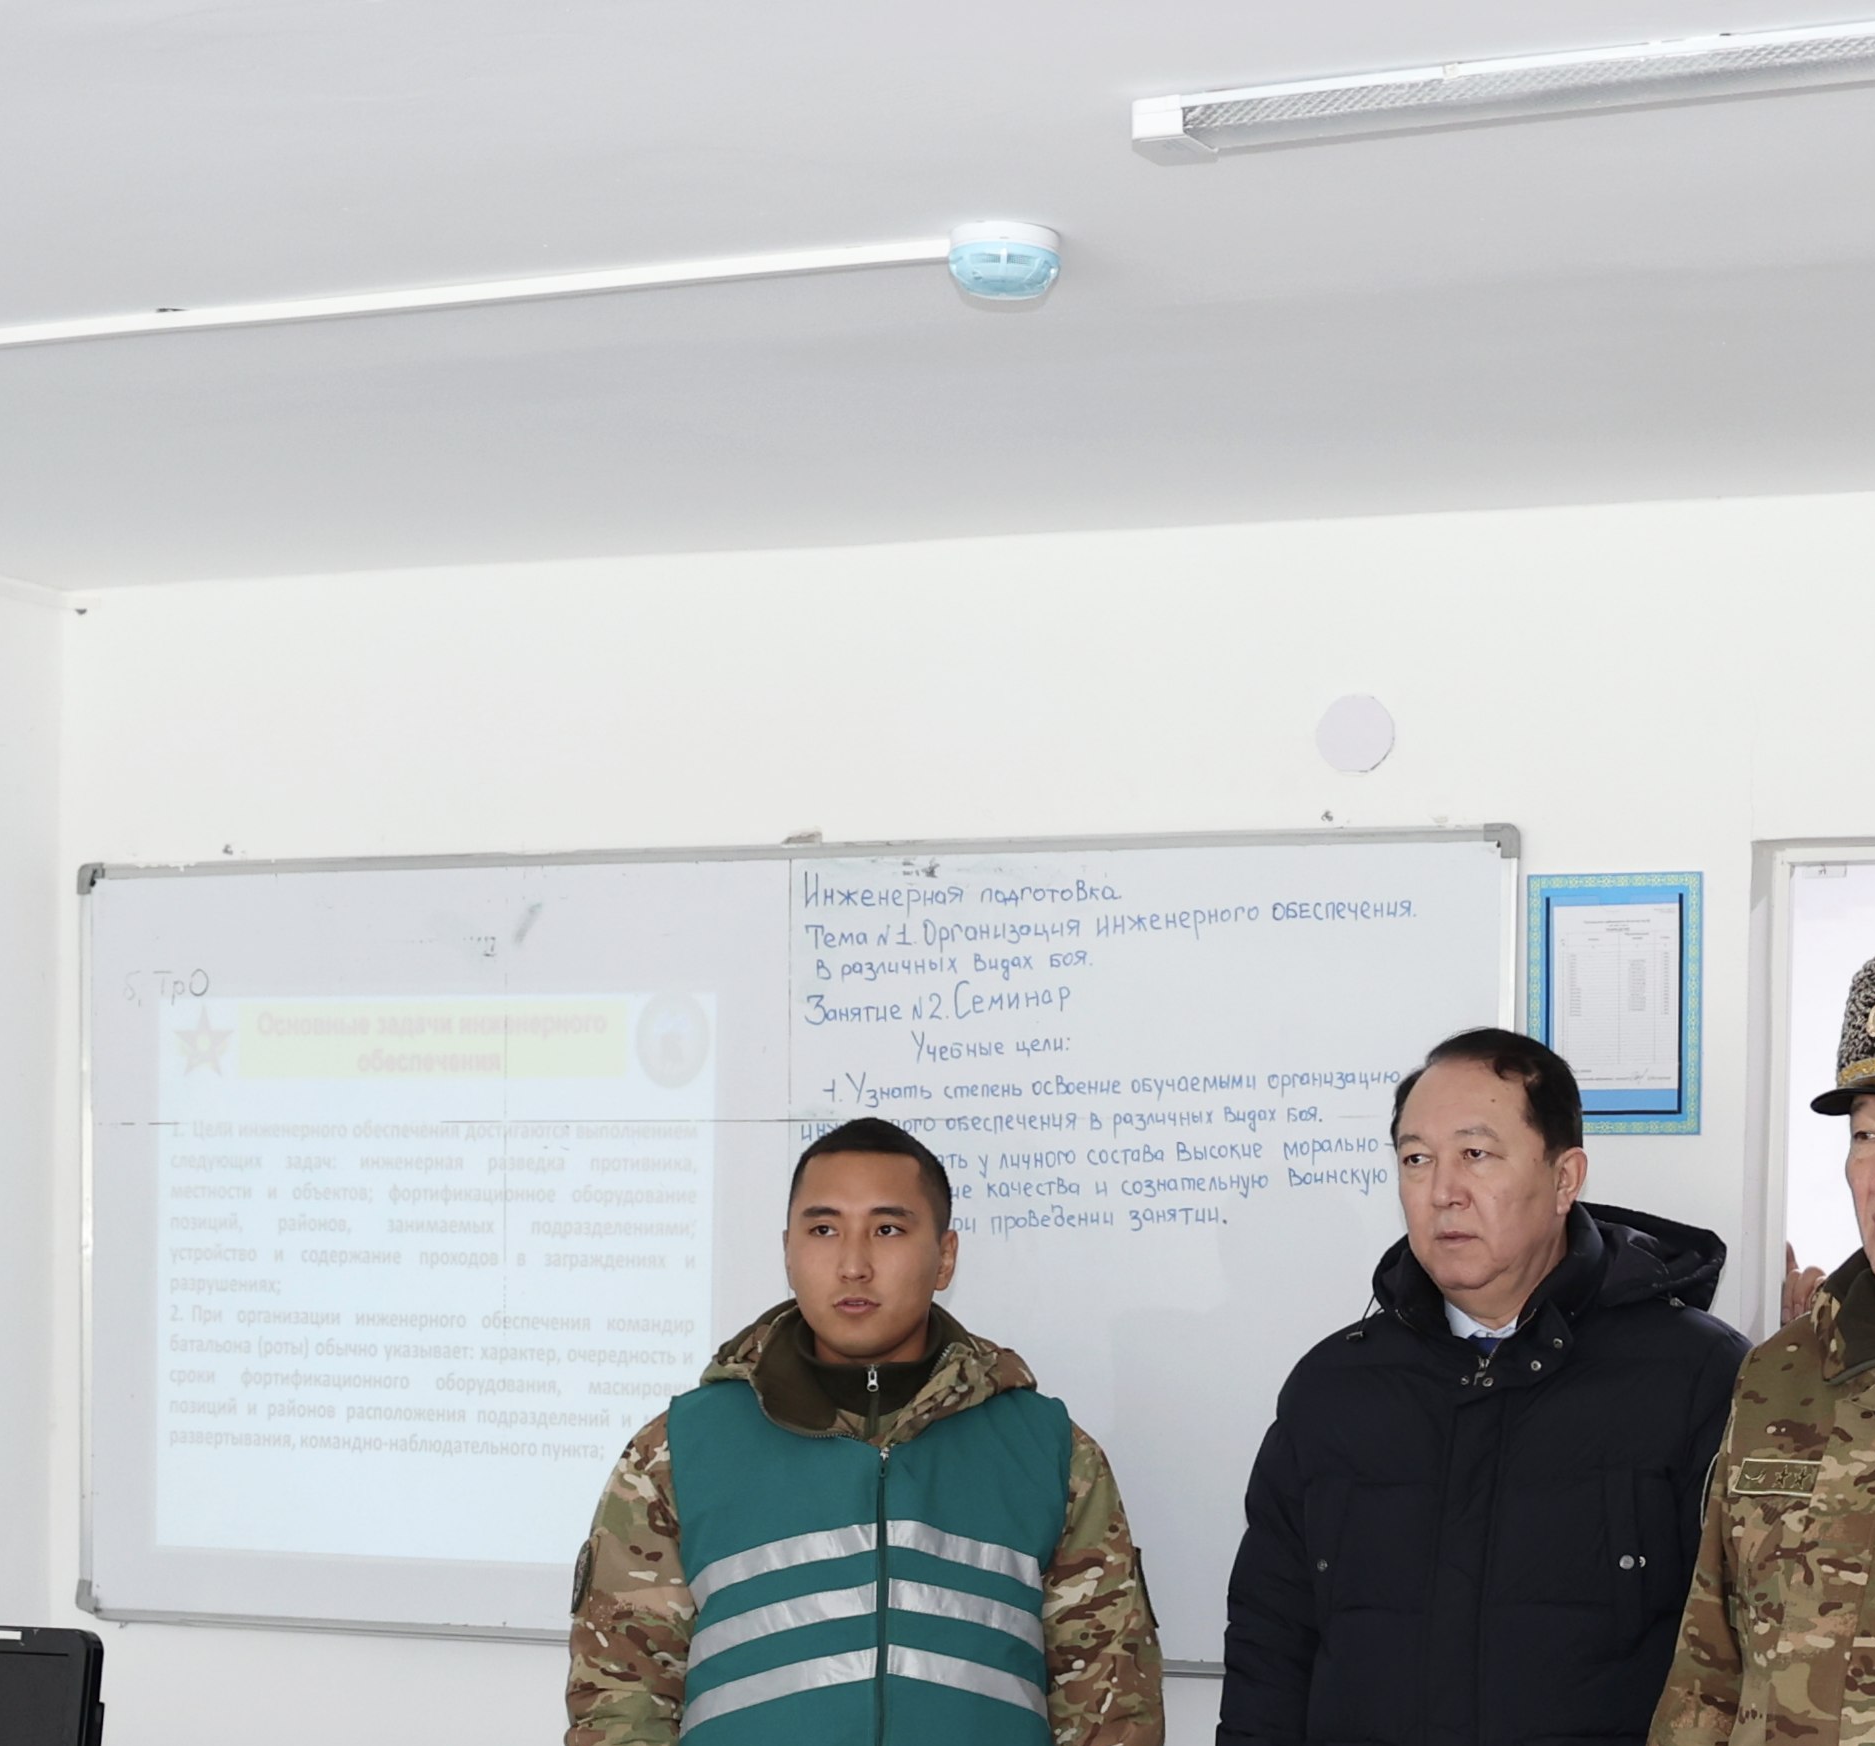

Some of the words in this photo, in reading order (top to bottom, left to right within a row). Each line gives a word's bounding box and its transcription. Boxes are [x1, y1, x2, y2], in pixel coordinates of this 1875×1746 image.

[805, 871, 964, 917] Инженерная
[805, 924, 868, 949] Тема
[842, 957, 958, 982] различных
[805, 994, 903, 1025] Занятие
[954, 980, 1071, 1021] Семинар
[911, 1030, 1005, 1064] Учебные
[846, 1072, 932, 1108] Узнать
[944, 1083, 1023, 1100] степень
[1131, 1074, 1256, 1101] обучаемыми
[946, 1112, 1077, 1134] обеспечения
[1113, 1109, 1213, 1138] различных
[999, 1151, 1077, 1169] личного
[1122, 1173, 1270, 1199] сознательную
